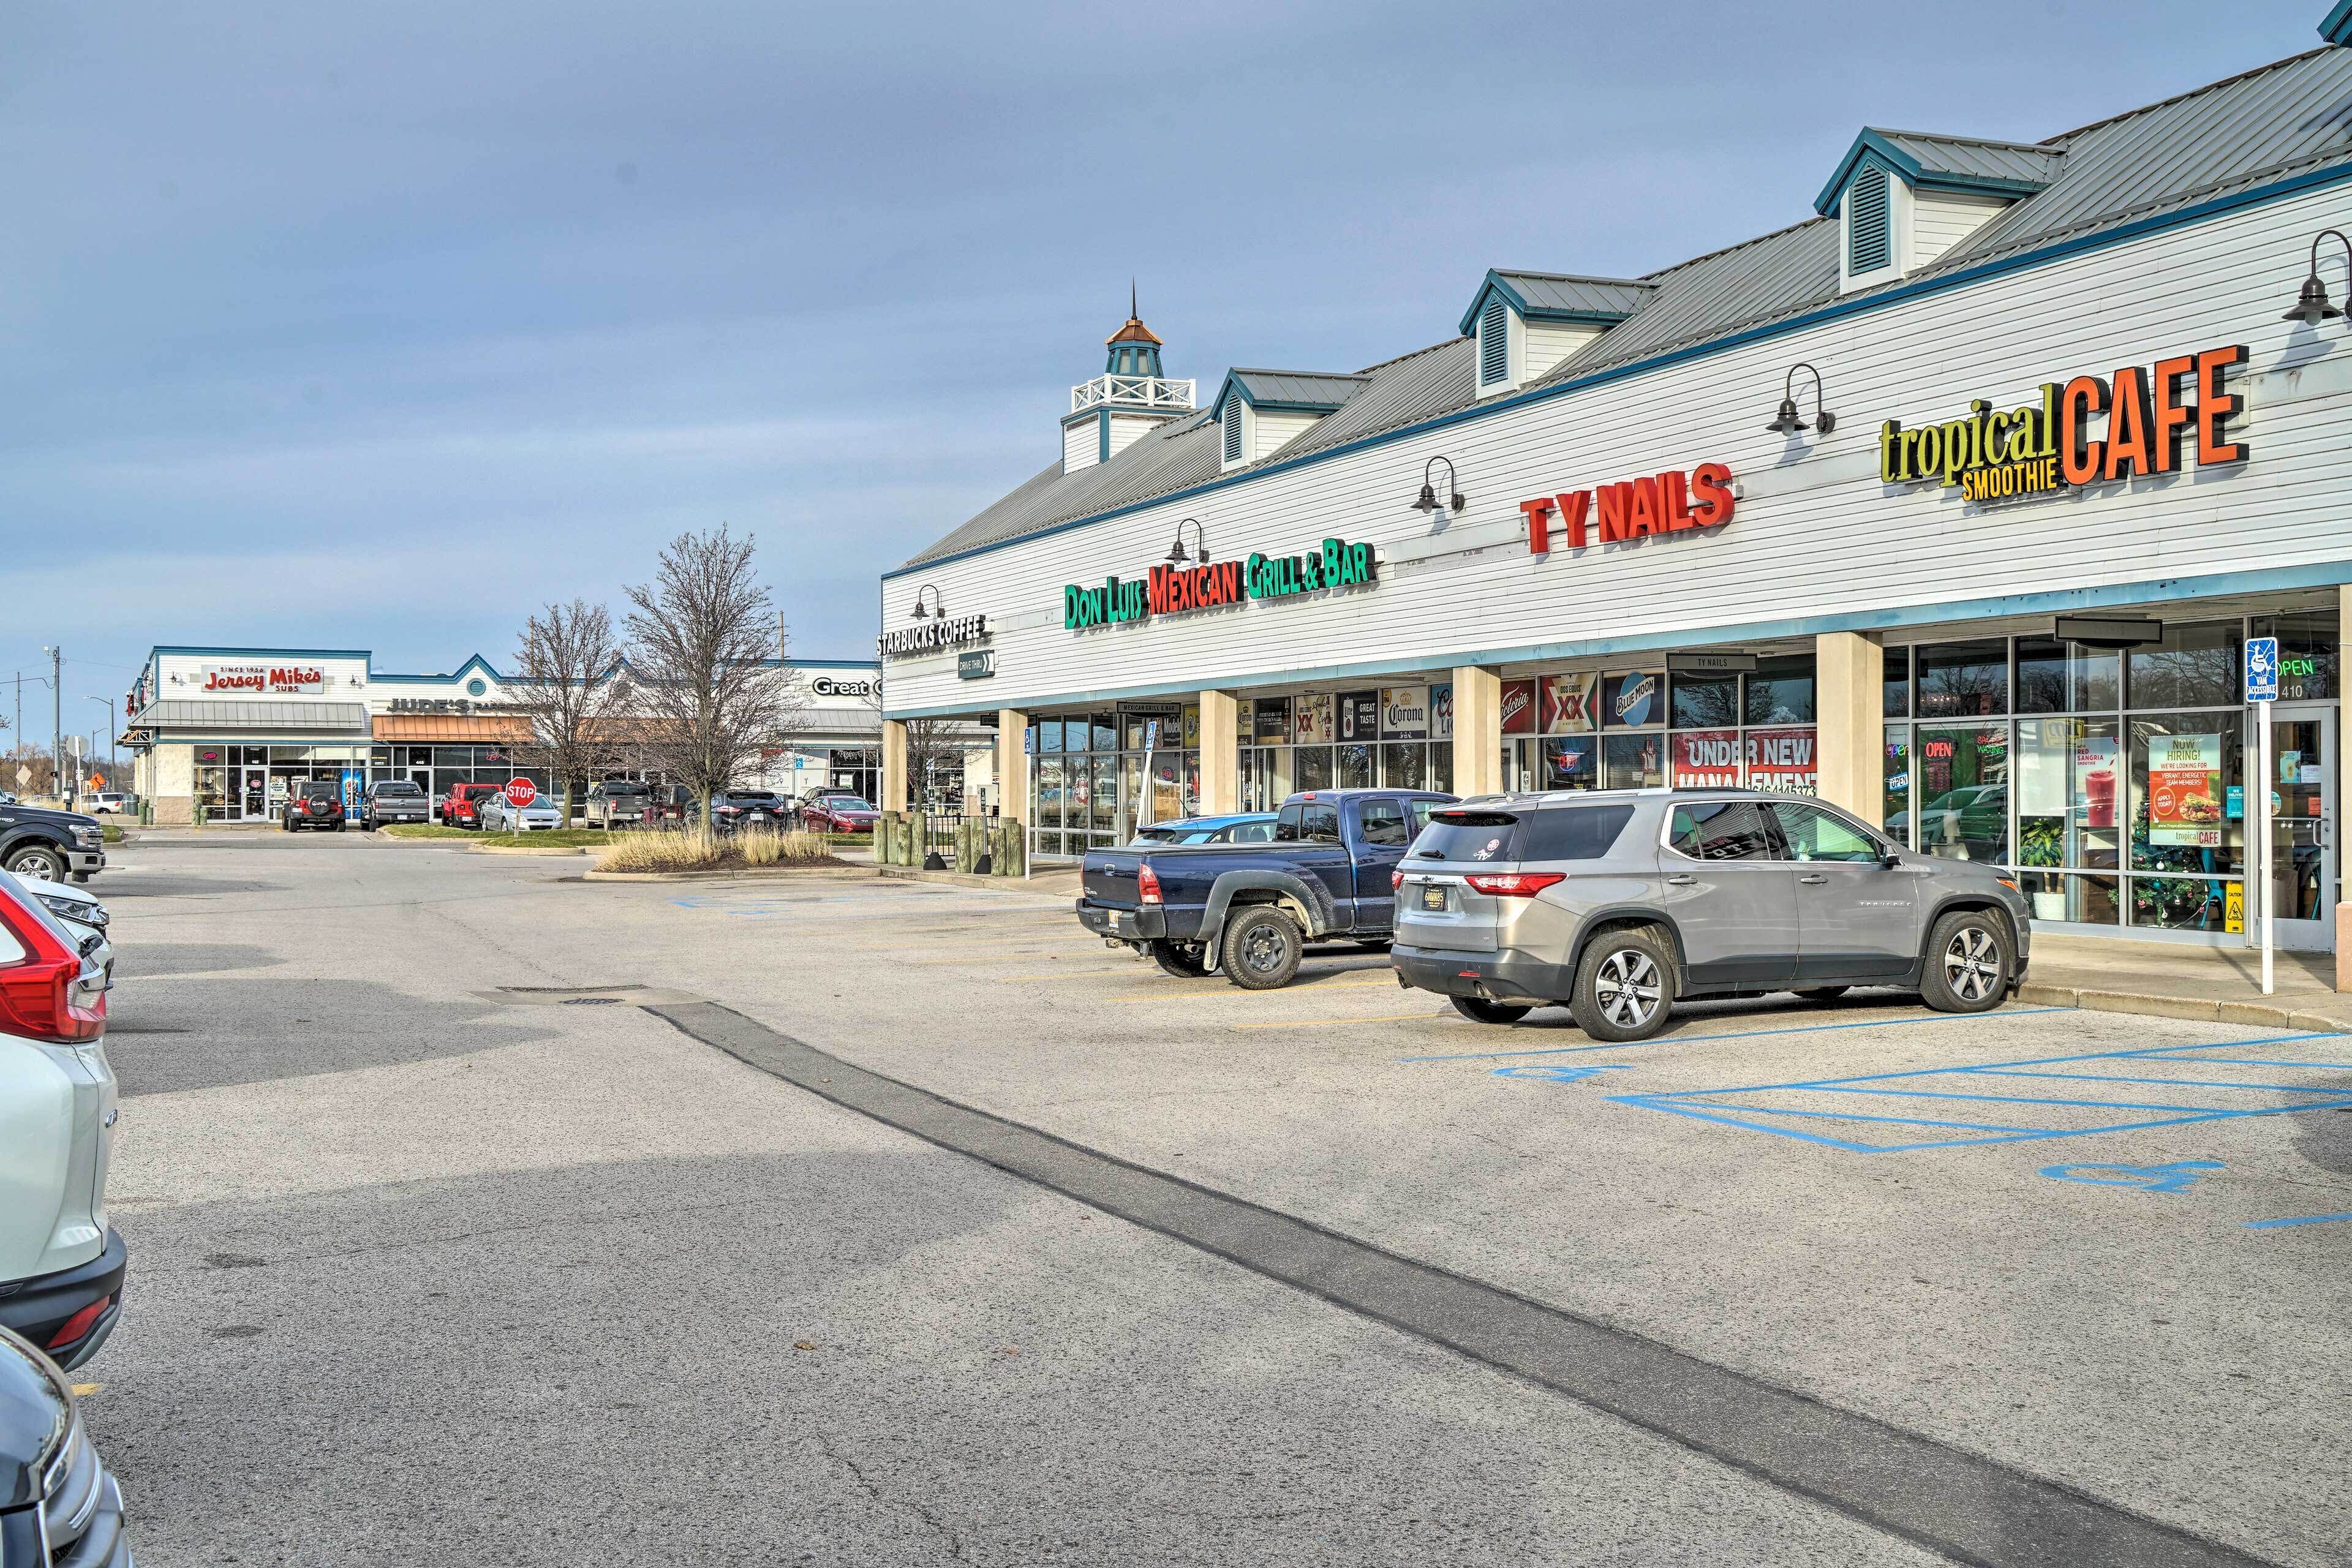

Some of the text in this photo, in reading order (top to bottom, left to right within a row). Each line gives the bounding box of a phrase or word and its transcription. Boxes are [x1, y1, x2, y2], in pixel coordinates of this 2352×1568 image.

[2062, 344, 2243, 486] CAFE
[1879, 383, 2056, 488] tropical
[1962, 458, 2057, 502] SMOOTHIE
[1596, 462, 1735, 543] NAILS
[1065, 538, 1372, 630] DON LUIS MEXICAN GRILL & BAR
[876, 614, 985, 656] STARBUCKS COFFEE
[959, 660, 982, 671] DRIVE THRU
[204, 667, 321, 691] Jersey Mike's
[813, 677, 869, 696] Great
[1569, 684, 1581, 693] EQUIS
[2247, 685, 2276, 695] ACCESSIBLE
[2282, 685, 2302, 698] 410
[386, 698, 470, 714] JUDE'S
[1616, 679, 1654, 716] BLUE MOON
[1359, 703, 1376, 712] GREAT
[1389, 703, 1423, 728] Corona
[1557, 694, 1585, 721] XX
[1297, 714, 1314, 732] XX
[1359, 715, 1376, 724] TASTE
[1689, 738, 1814, 767] UNDER NEW
[1926, 742, 1952, 757] OPEN
[2173, 740, 2195, 750] NOW
[2167, 750, 2201, 761] HIRING!
[1891, 775, 1907, 788] OPEN
[507, 786, 535, 799] STOP
[2176, 832, 2218, 844] tropical CAFE
